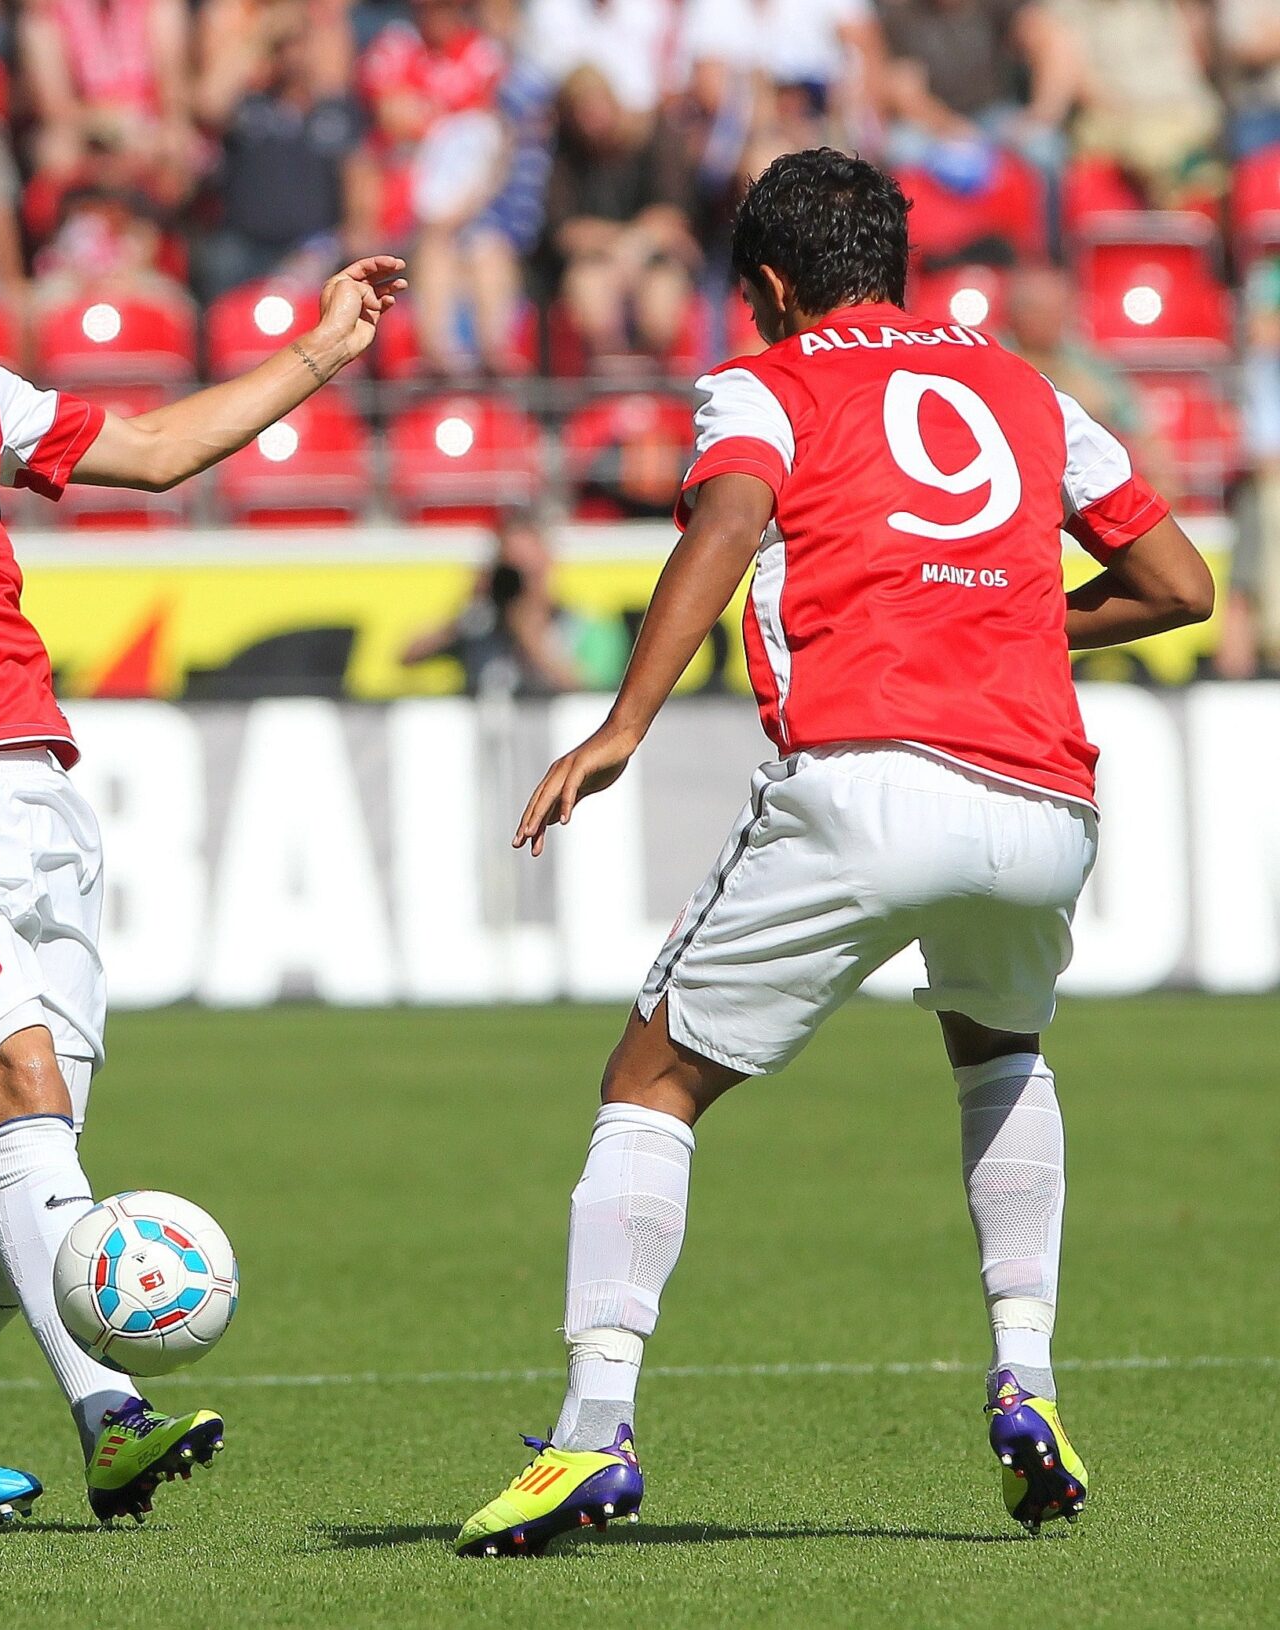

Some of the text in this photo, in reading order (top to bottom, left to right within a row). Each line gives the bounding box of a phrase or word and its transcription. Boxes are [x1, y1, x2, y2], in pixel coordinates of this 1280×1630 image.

[799, 325, 989, 356] ALLAGUI
[883, 368, 1023, 542] 9
[921, 563, 1009, 588] MAINZ 05
